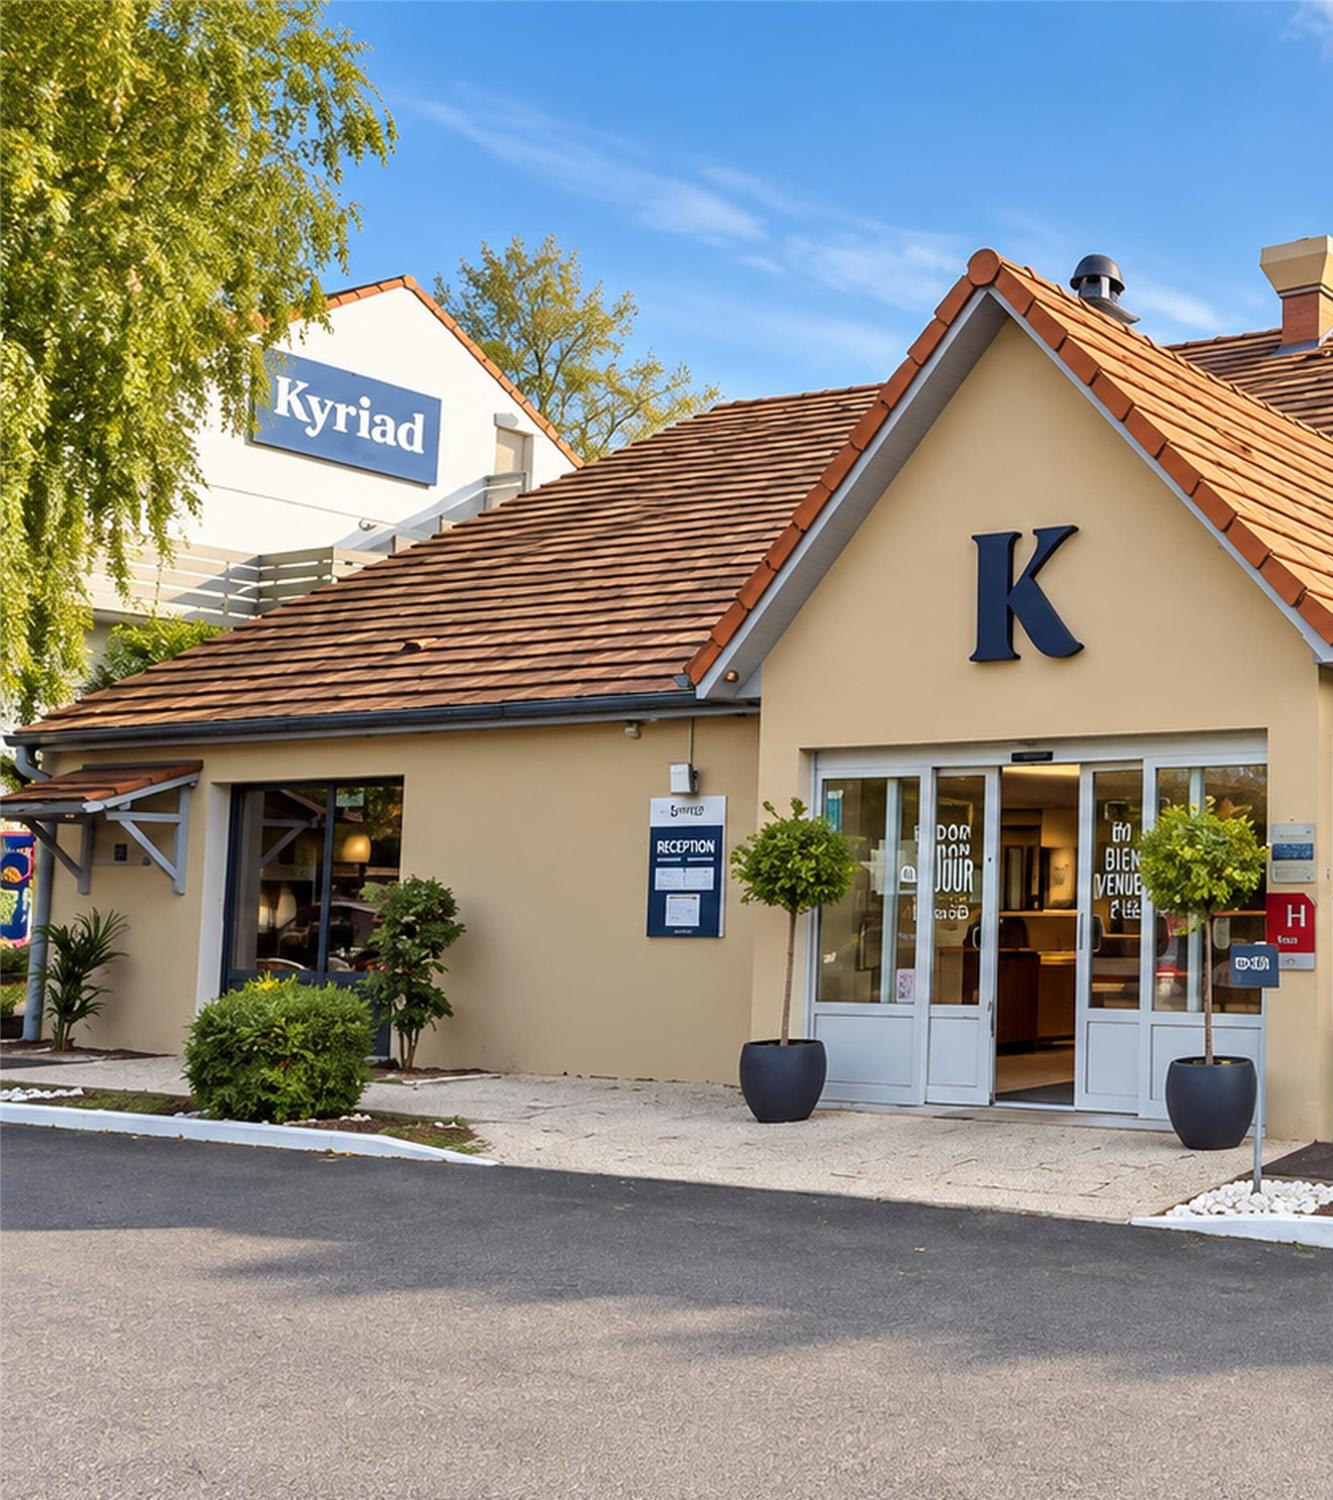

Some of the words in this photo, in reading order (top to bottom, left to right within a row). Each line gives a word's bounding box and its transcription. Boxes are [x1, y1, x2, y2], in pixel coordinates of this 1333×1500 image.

[274, 374, 425, 455] Kyriad
[969, 525, 1085, 662] K
[657, 840, 716, 854] RECEPTION
[1105, 847, 1141, 871] BIEN
[934, 858, 973, 893] JOUR
[1287, 904, 1306, 928] H
